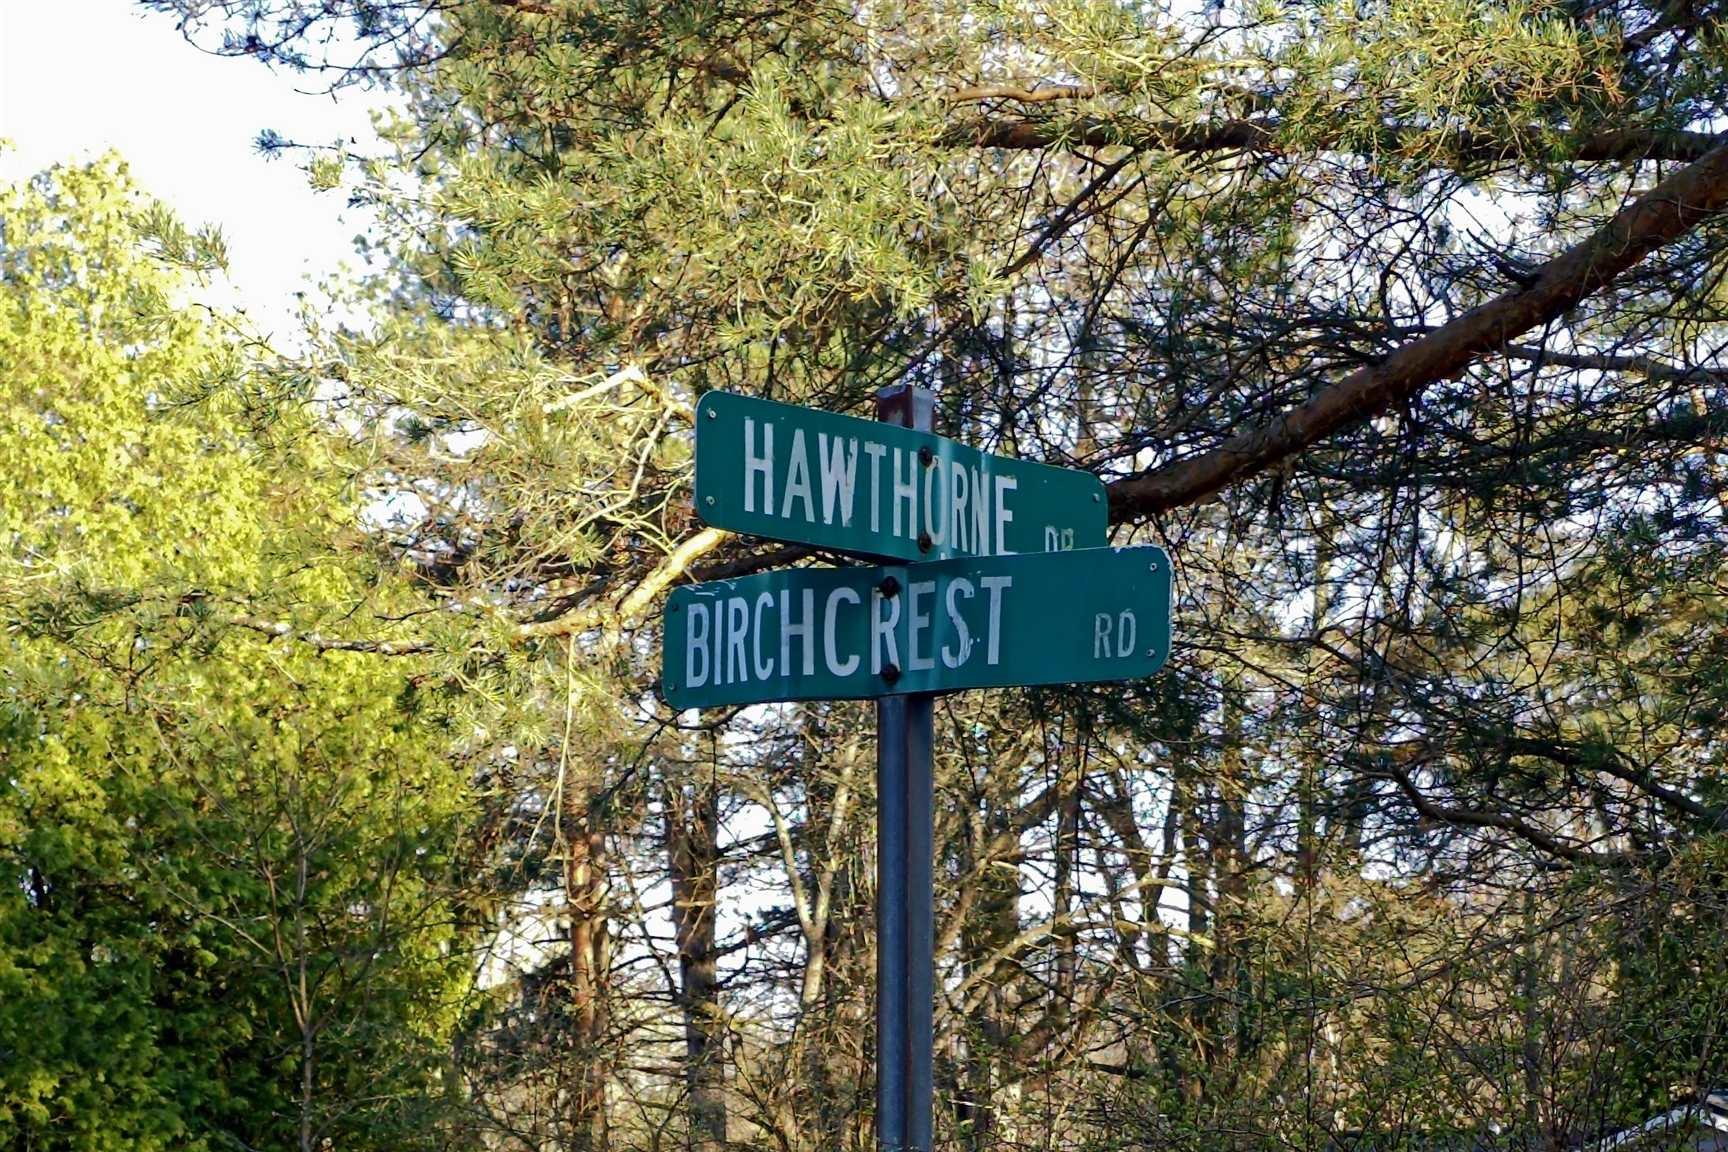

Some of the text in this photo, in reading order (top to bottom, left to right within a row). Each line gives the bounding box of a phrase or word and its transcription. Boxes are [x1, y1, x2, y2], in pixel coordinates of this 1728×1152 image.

[744, 415, 1018, 557] HAWTHORNE
[685, 575, 1137, 689] BIRCHCREST RD
